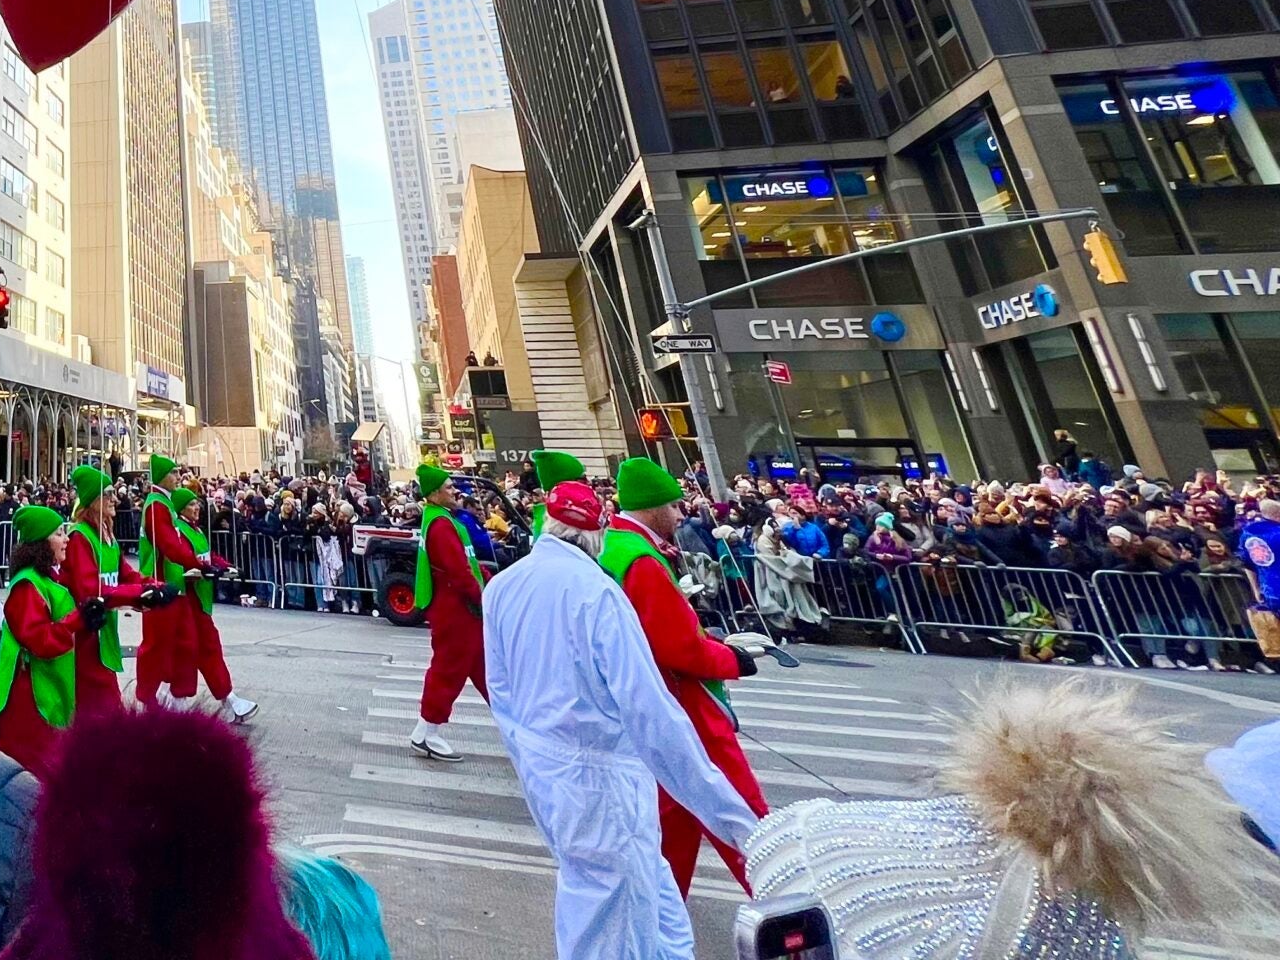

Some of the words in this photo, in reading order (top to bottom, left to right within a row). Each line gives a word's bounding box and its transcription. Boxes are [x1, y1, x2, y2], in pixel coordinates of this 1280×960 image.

[742, 181, 809, 197] CHASE
[977, 292, 1041, 329] CHASE
[748, 317, 869, 340] CHASE
[660, 340, 679, 348] ONE
[688, 340, 709, 348] WAY
